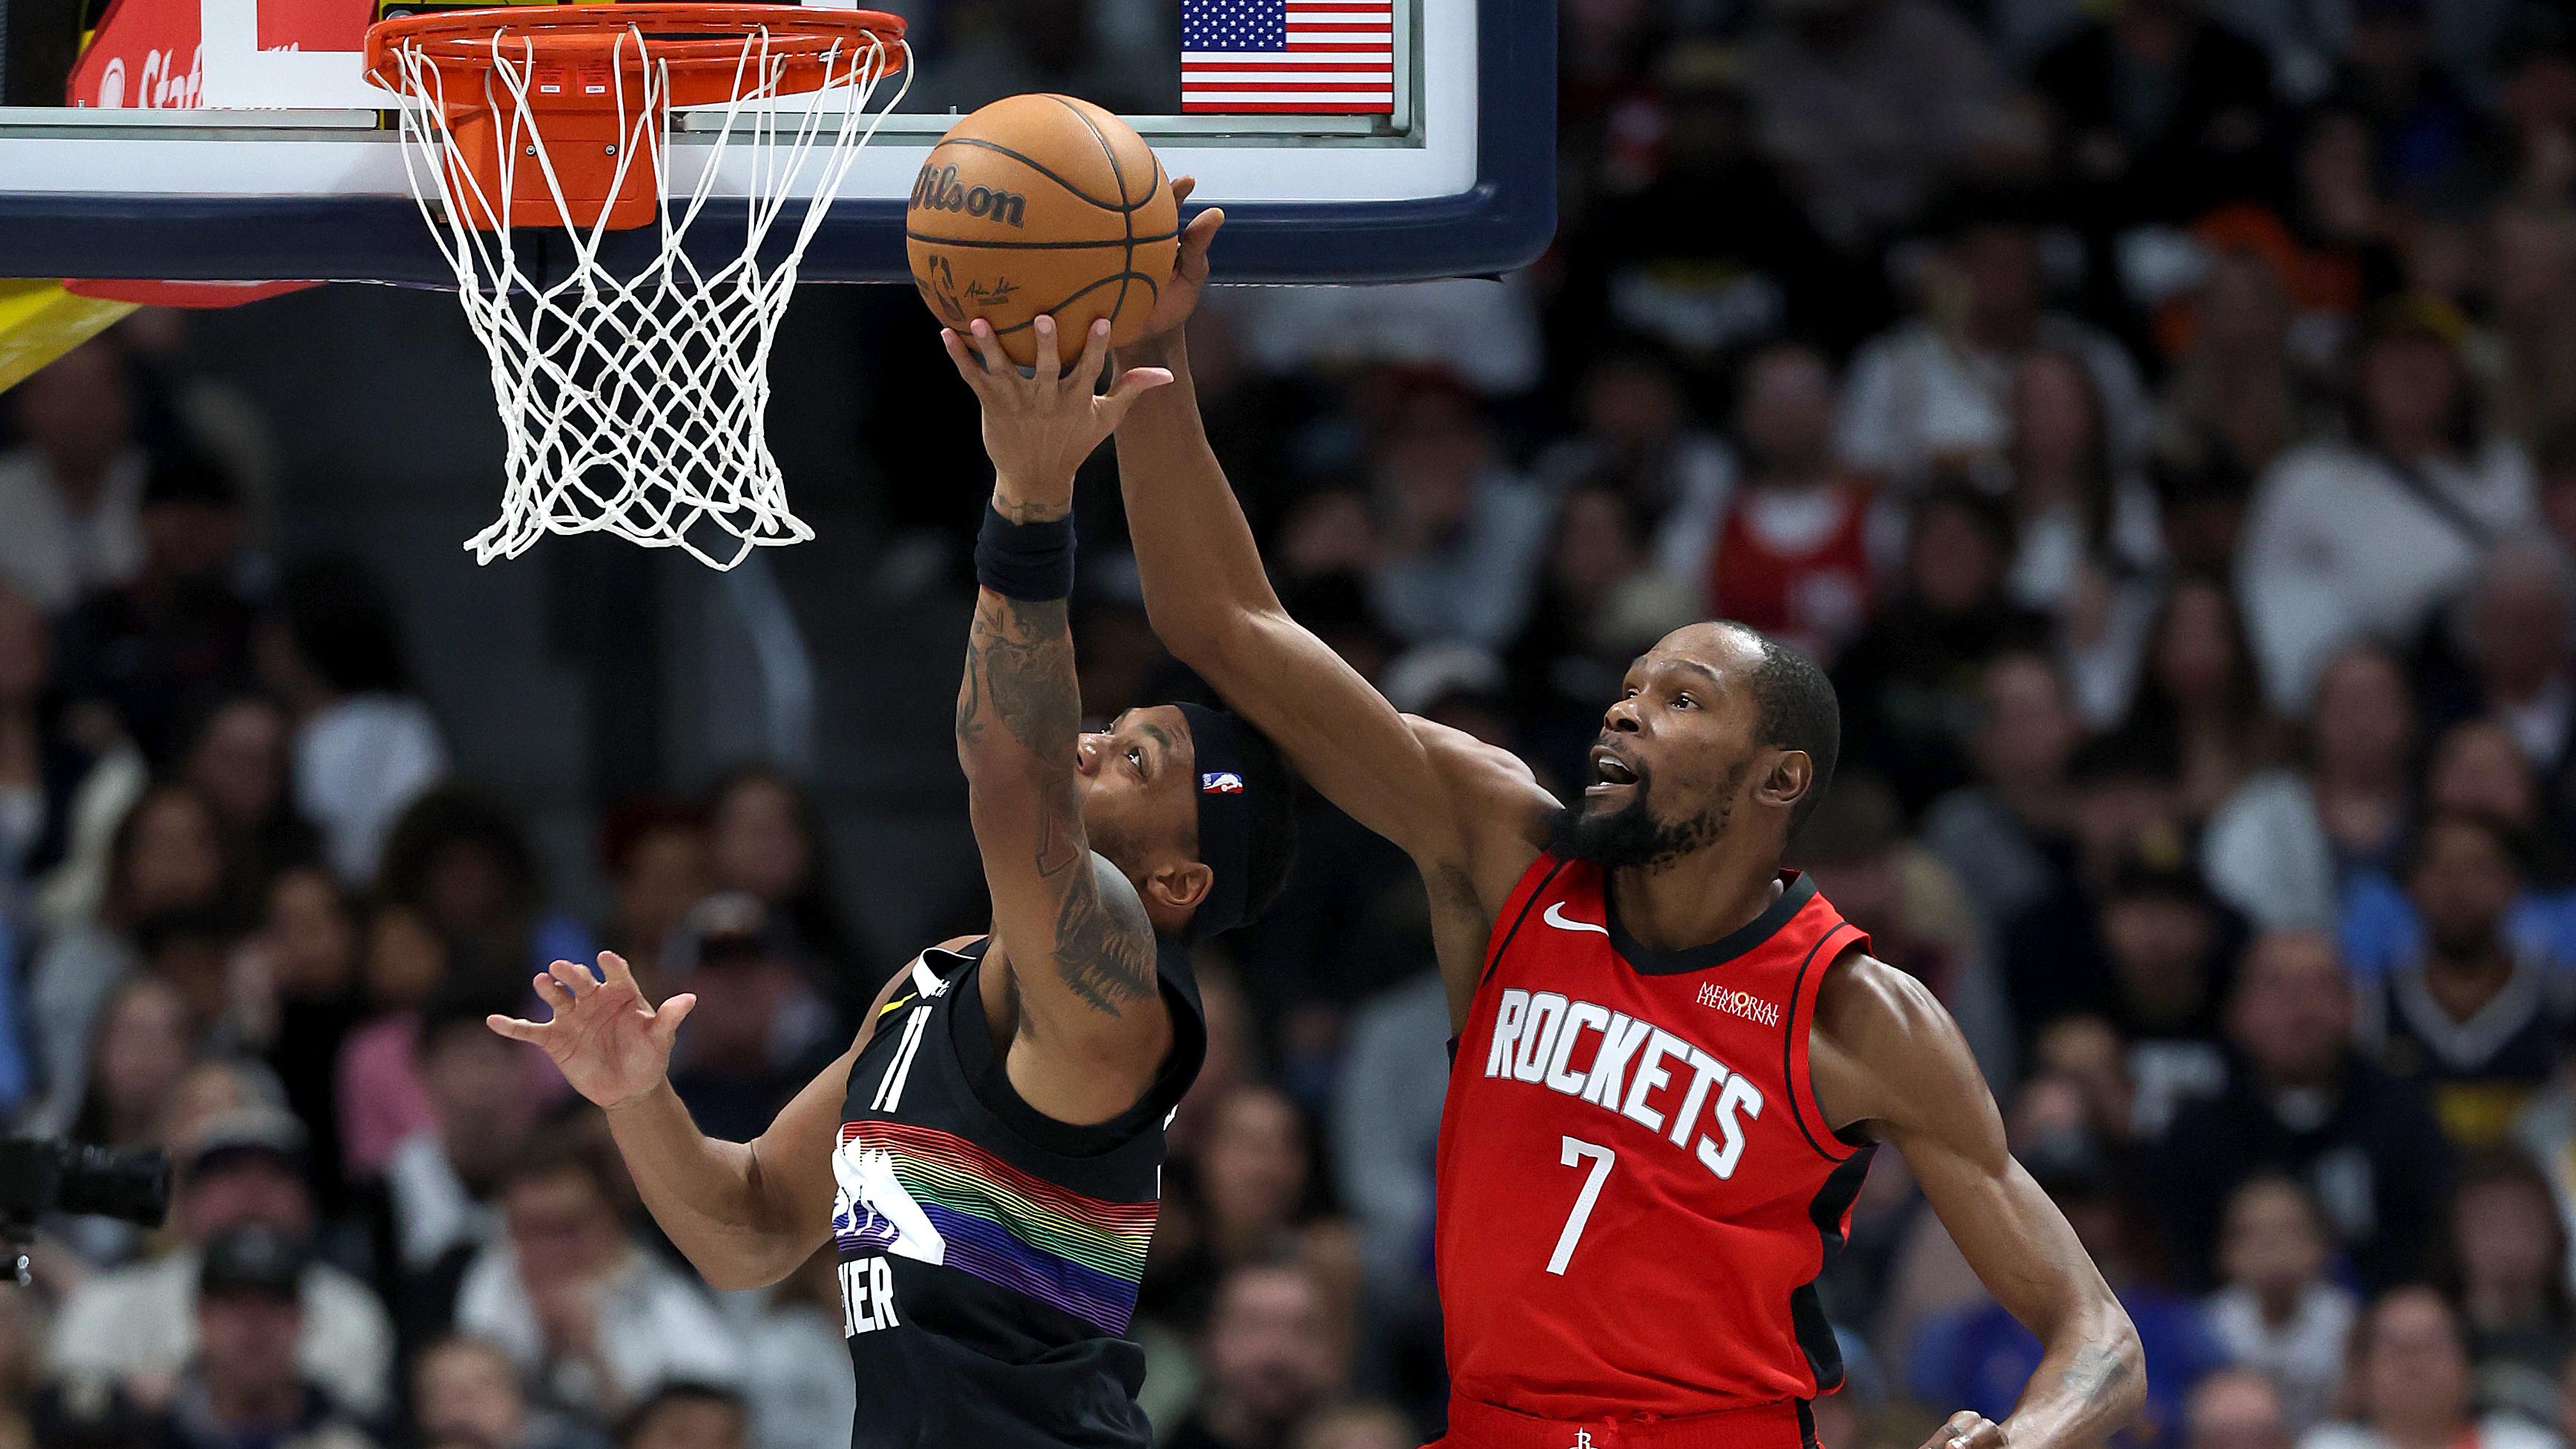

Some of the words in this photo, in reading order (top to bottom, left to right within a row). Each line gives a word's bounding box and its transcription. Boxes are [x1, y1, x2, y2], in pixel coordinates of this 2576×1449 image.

[1696, 990, 1779, 1028] HERMANN
[1698, 981, 1779, 1017] MEMORIAL
[869, 1005, 933, 1113] 11
[1484, 988, 1764, 1180] ROCKETS
[1546, 1135, 1615, 1276] 7
